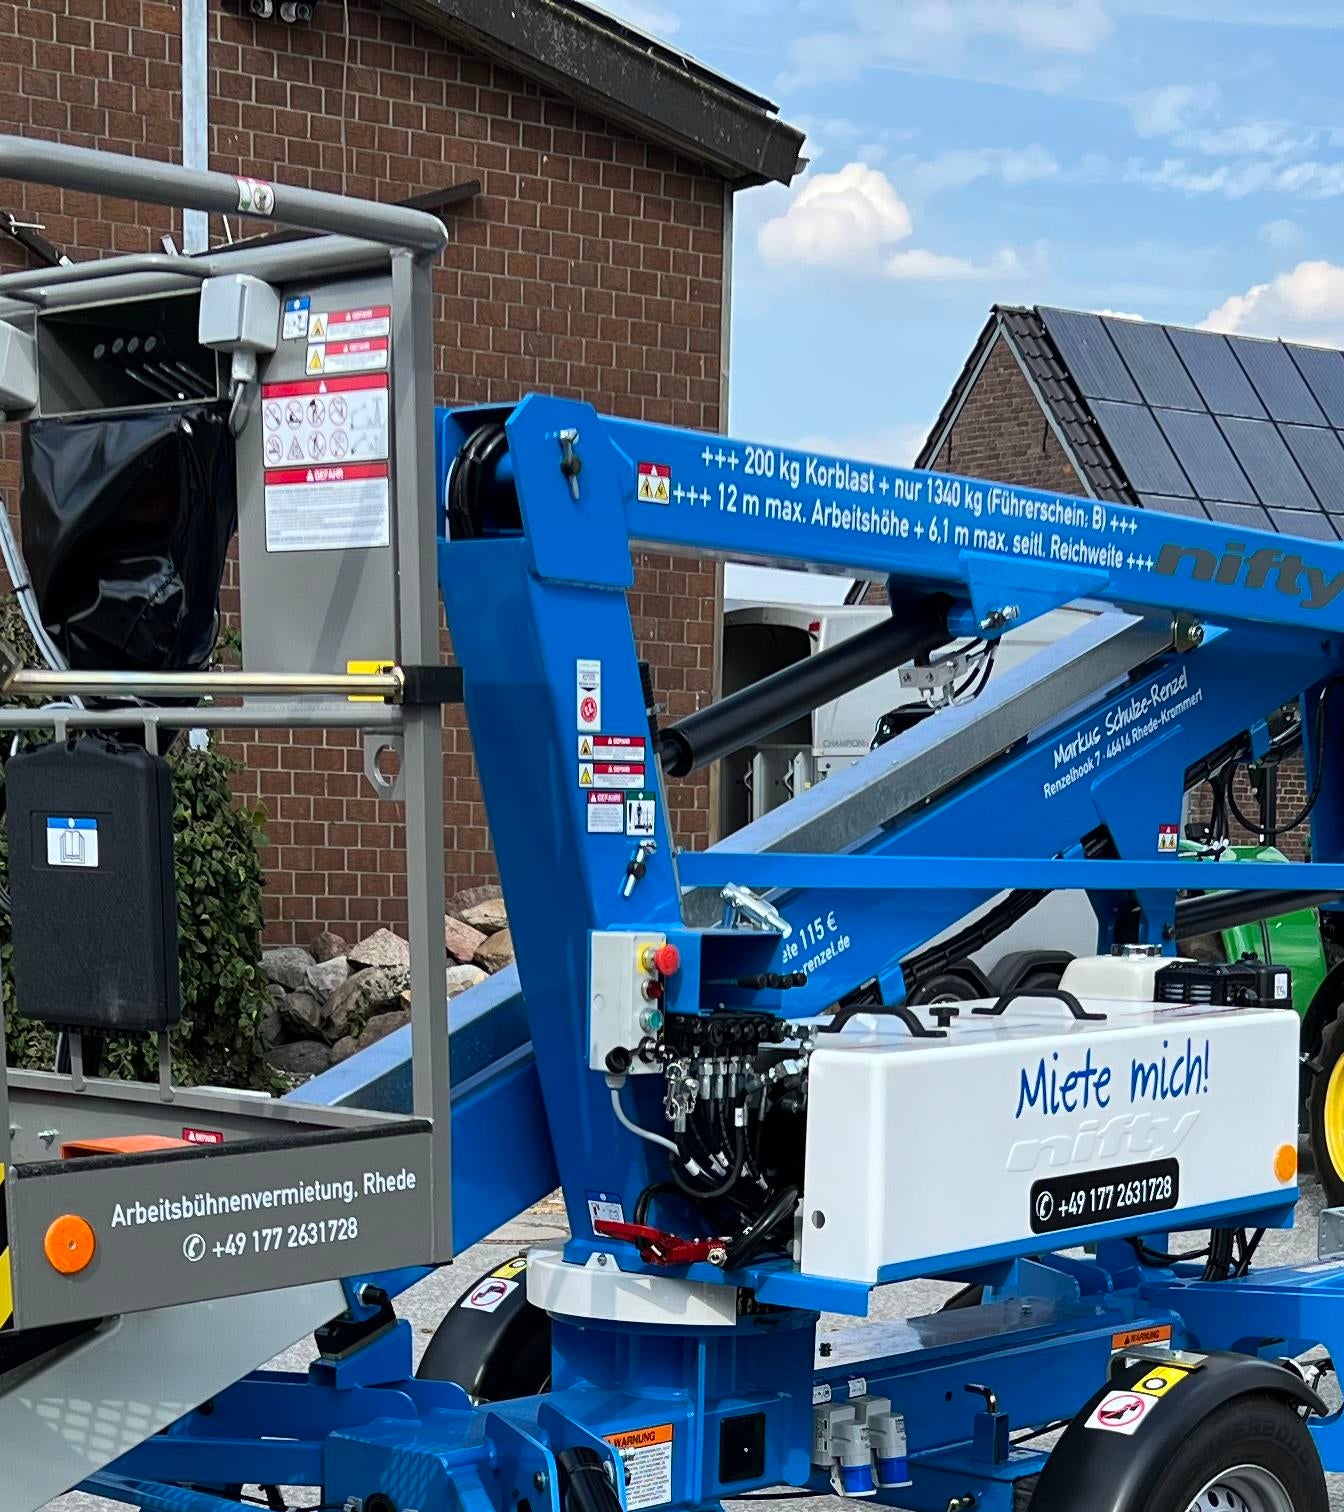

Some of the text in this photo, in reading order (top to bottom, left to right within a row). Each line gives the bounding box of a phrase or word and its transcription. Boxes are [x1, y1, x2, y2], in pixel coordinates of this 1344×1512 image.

[744, 446, 775, 479] 200
[779, 452, 800, 490] kg
[805, 456, 875, 494] Korblast
[894, 476, 923, 502] nur
[926, 477, 961, 508] 1340
[964, 485, 983, 517] kg
[1092, 504, 1106, 533] B)
[718, 482, 738, 513] 12
[742, 493, 759, 517] m
[765, 497, 807, 524] max.
[810, 497, 910, 539] Arbeitshöhe
[954, 523, 969, 547] m
[973, 528, 1008, 553] max.
[1012, 530, 1046, 558] seitl.
[1050, 534, 1124, 570] Reichweite
[1052, 664, 1189, 770] Markus Schulze-Renzel
[1043, 756, 1096, 800] Renzelhook
[1094, 750, 1101, 766] 7
[1105, 736, 1132, 760] 46414
[799, 916, 825, 950] 115
[826, 910, 838, 932] €
[1015, 1037, 1209, 1119] Miete mich!
[1007, 1110, 1200, 1173] nifty
[363, 1168, 417, 1195] Rhede
[1058, 1175, 1172, 1217] +49 177 2631728
[212, 1216, 359, 1259] +49 177 2631728
[1131, 1330, 1160, 1343] WARNUNG
[614, 1431, 656, 1448] WARNUNG
